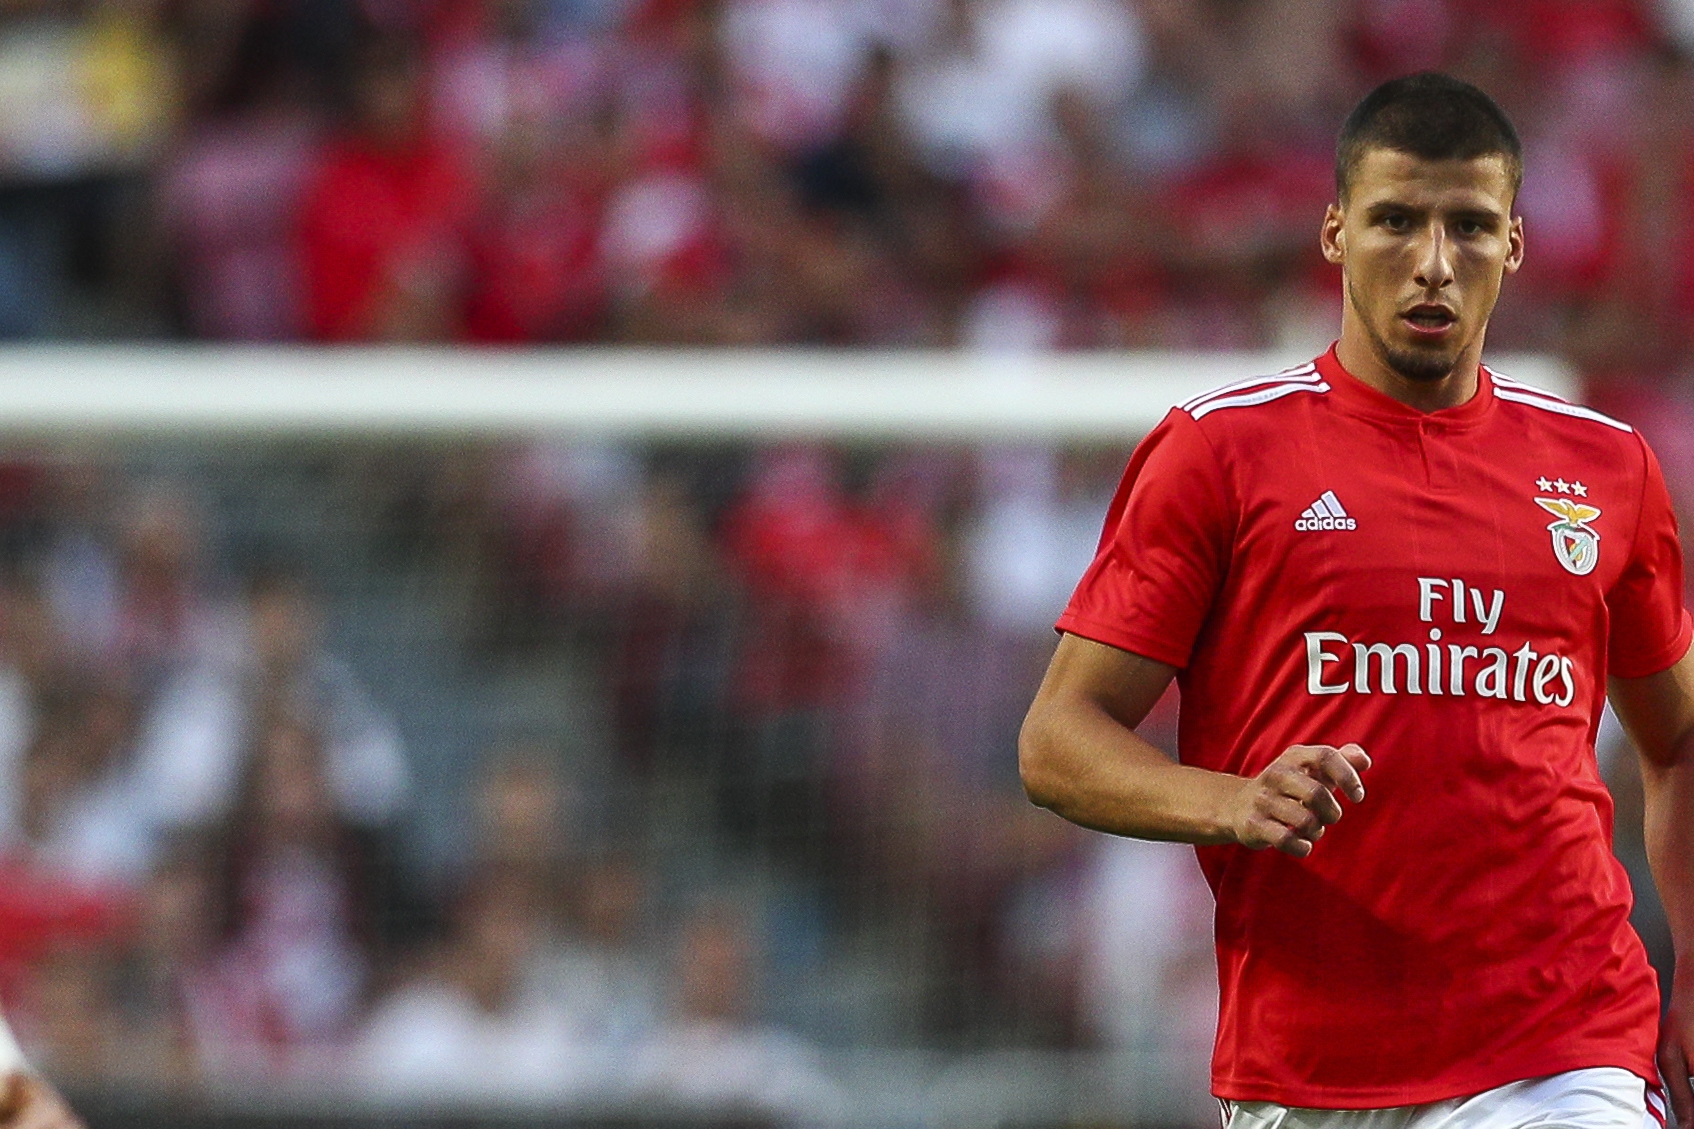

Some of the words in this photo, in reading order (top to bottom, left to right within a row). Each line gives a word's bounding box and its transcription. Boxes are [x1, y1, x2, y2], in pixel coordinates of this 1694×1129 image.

[1295, 515, 1358, 532] adidas
[1416, 576, 1505, 635] Fly
[1303, 628, 1576, 708] Emirates
